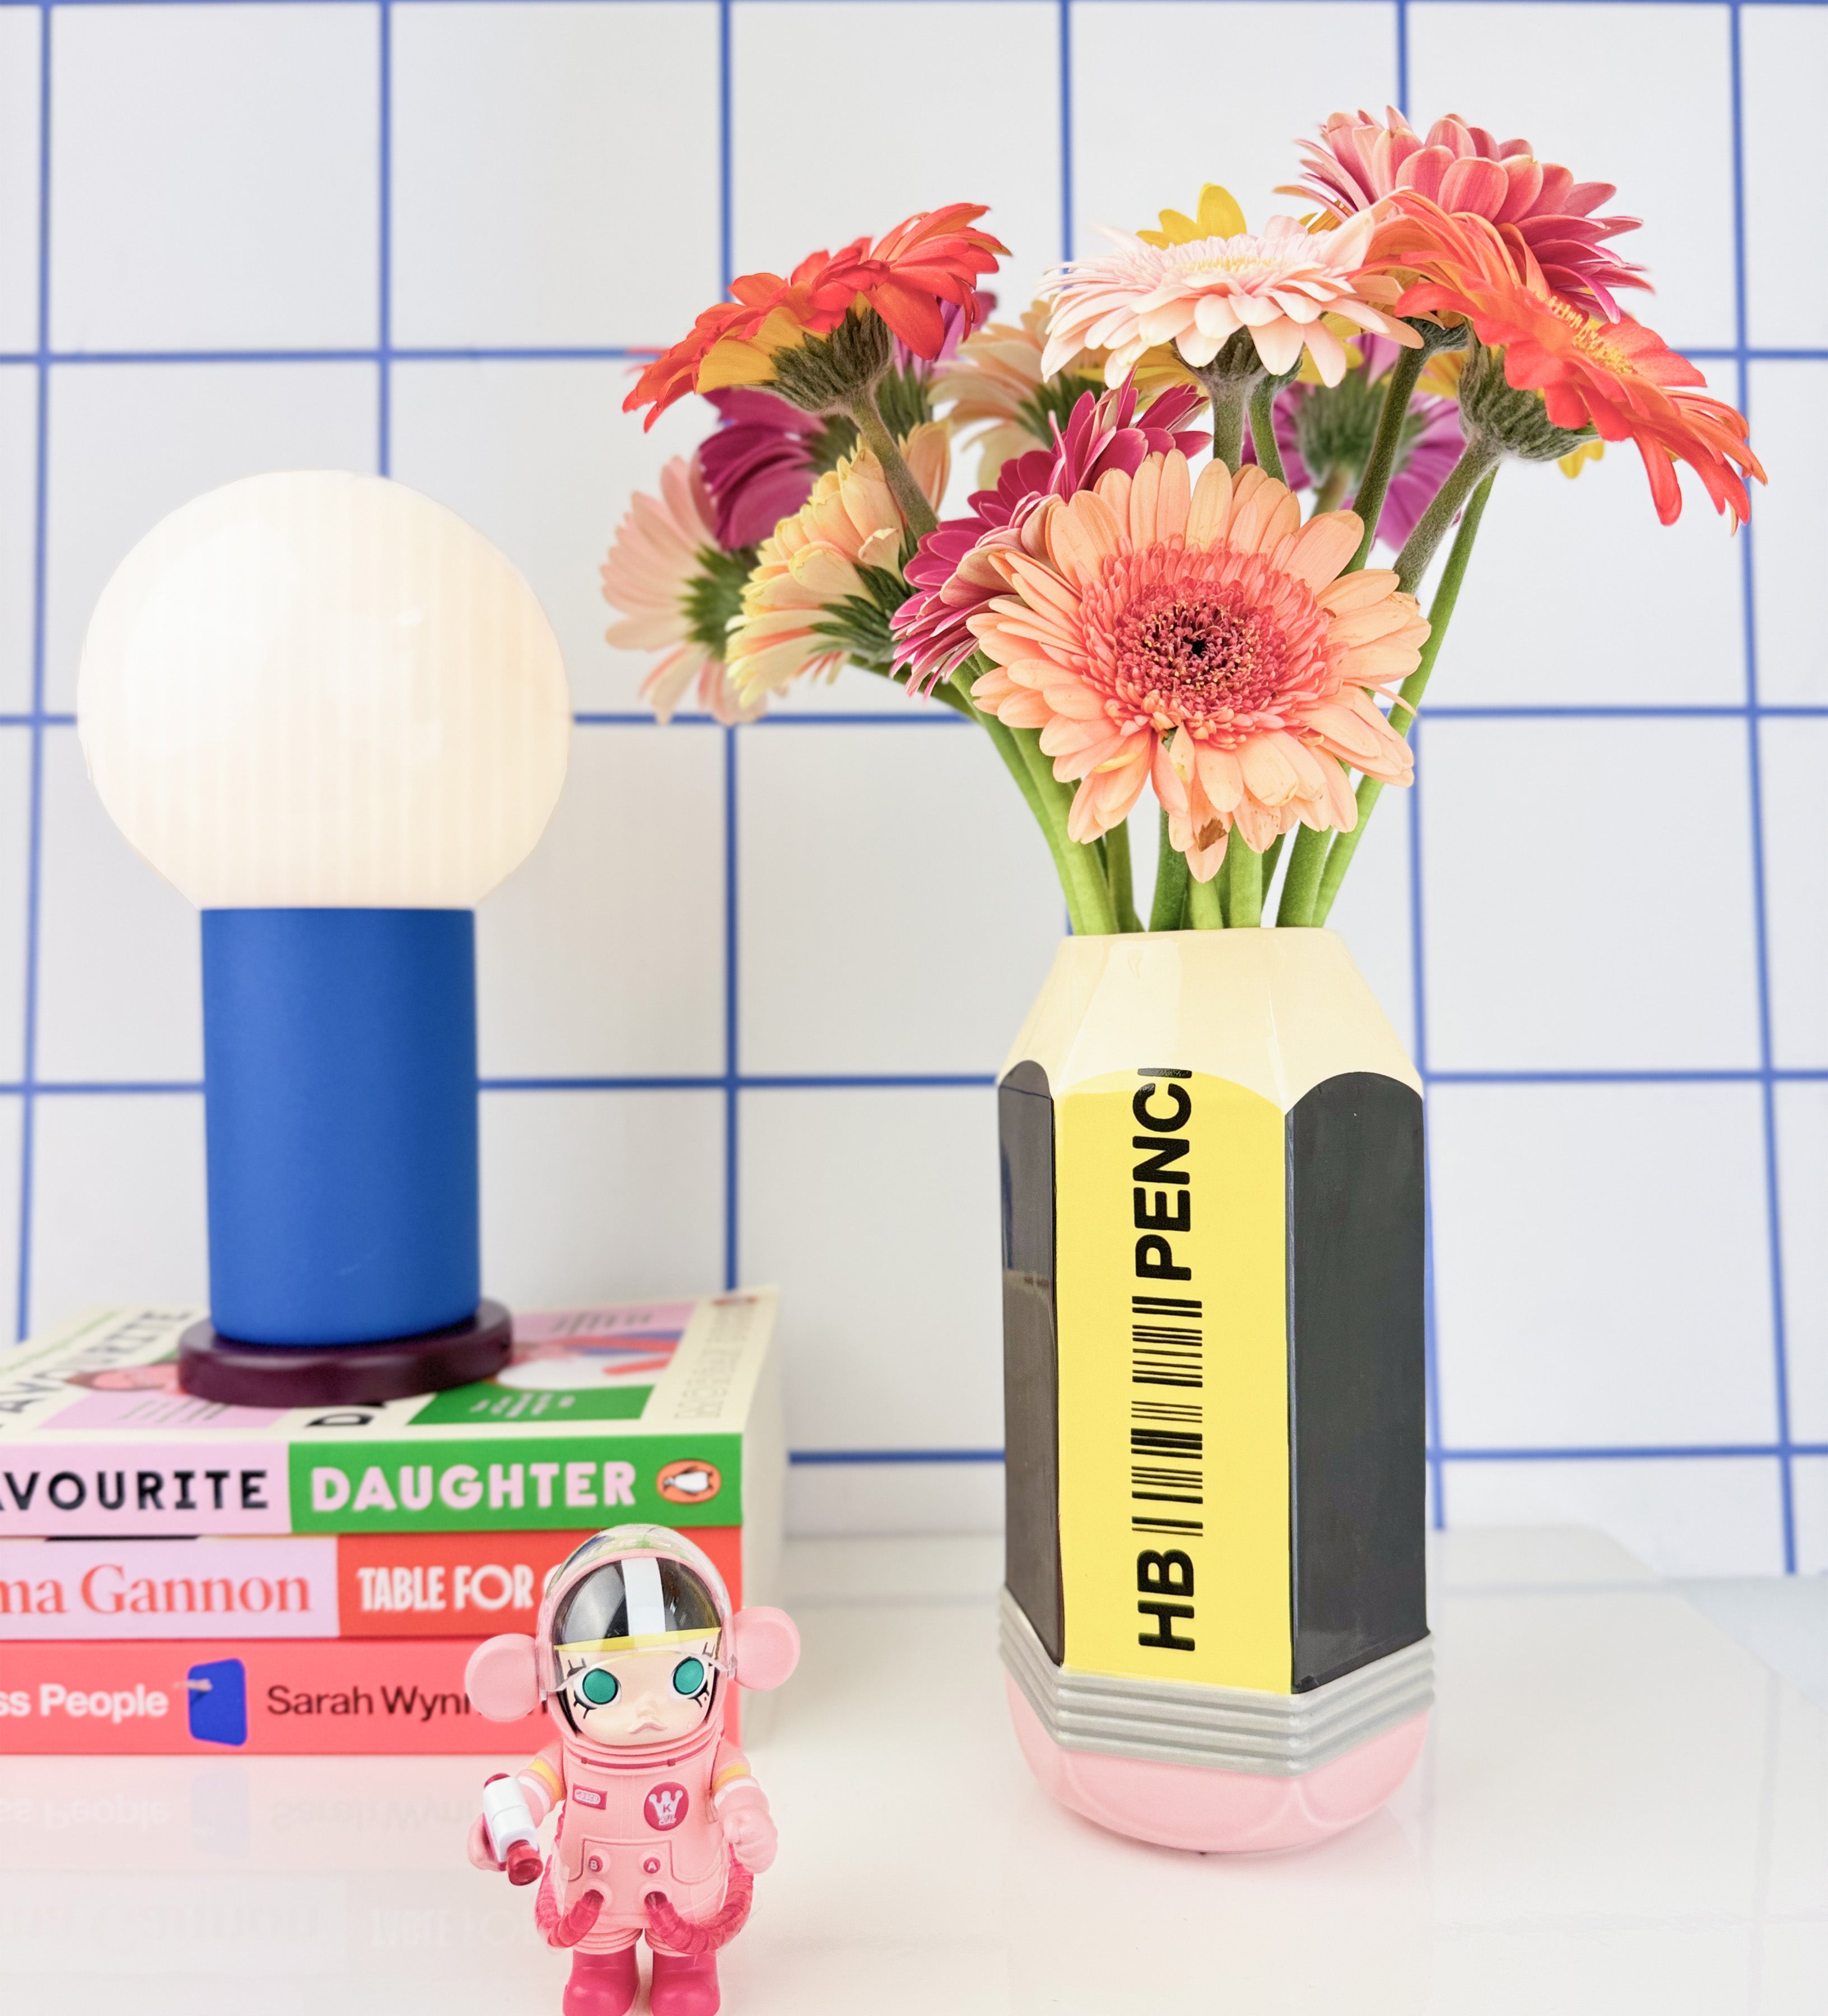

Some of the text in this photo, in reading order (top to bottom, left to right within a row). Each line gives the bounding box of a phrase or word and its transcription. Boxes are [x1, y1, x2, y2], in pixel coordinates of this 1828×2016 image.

[1132, 1067, 1195, 1651] HB PENCI
[0, 1461, 636, 1511] VOURITE DAUGHTER
[80, 1564, 311, 1614] Gannon
[357, 1566, 446, 1611] TABLE
[454, 1564, 534, 1610] FOR
[40, 1683, 169, 1724] People
[267, 1685, 373, 1715] Sarah
[663, 1803, 671, 1813] K
[590, 1860, 598, 1870] B
[647, 1861, 657, 1870] A
